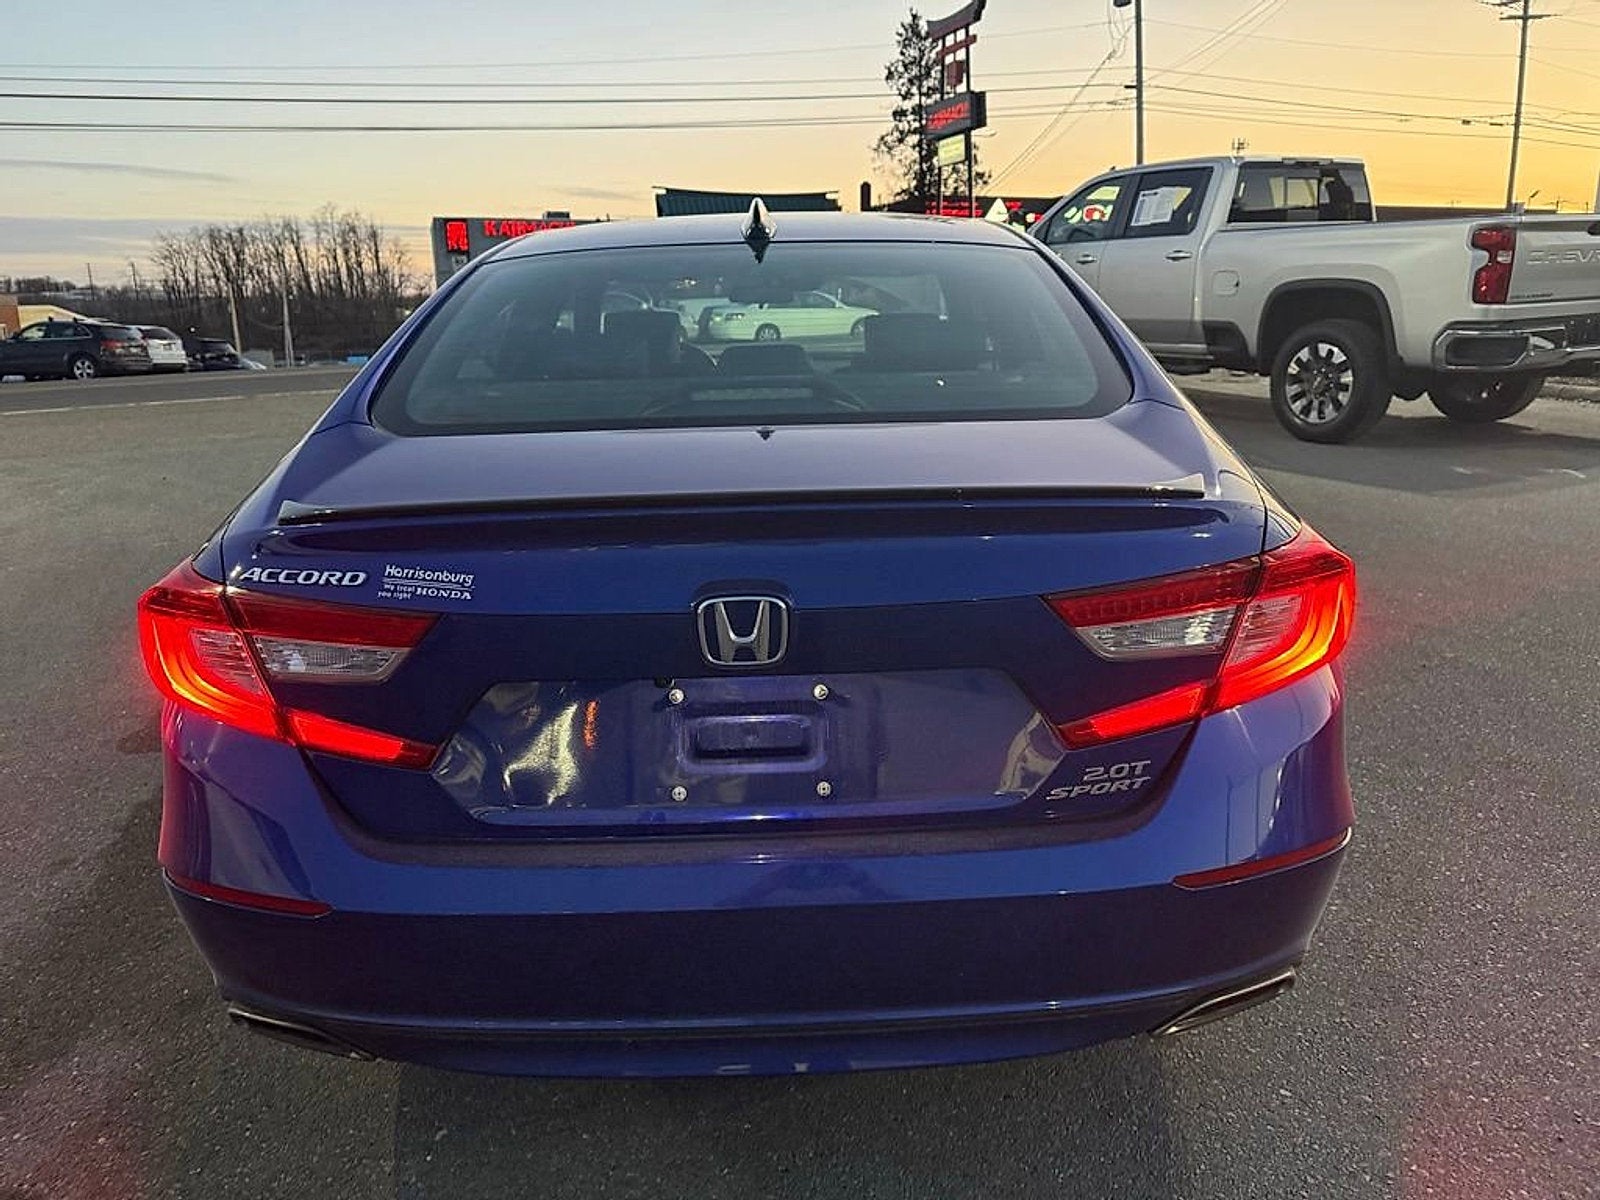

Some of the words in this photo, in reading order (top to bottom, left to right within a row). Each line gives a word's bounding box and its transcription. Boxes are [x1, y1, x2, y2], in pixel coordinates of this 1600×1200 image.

[239, 567, 367, 586] ACCORD
[384, 564, 475, 587] Harrisonburg
[415, 587, 472, 600] HONDA
[1083, 760, 1152, 781] 2.0T
[1046, 776, 1152, 800] SPORT
